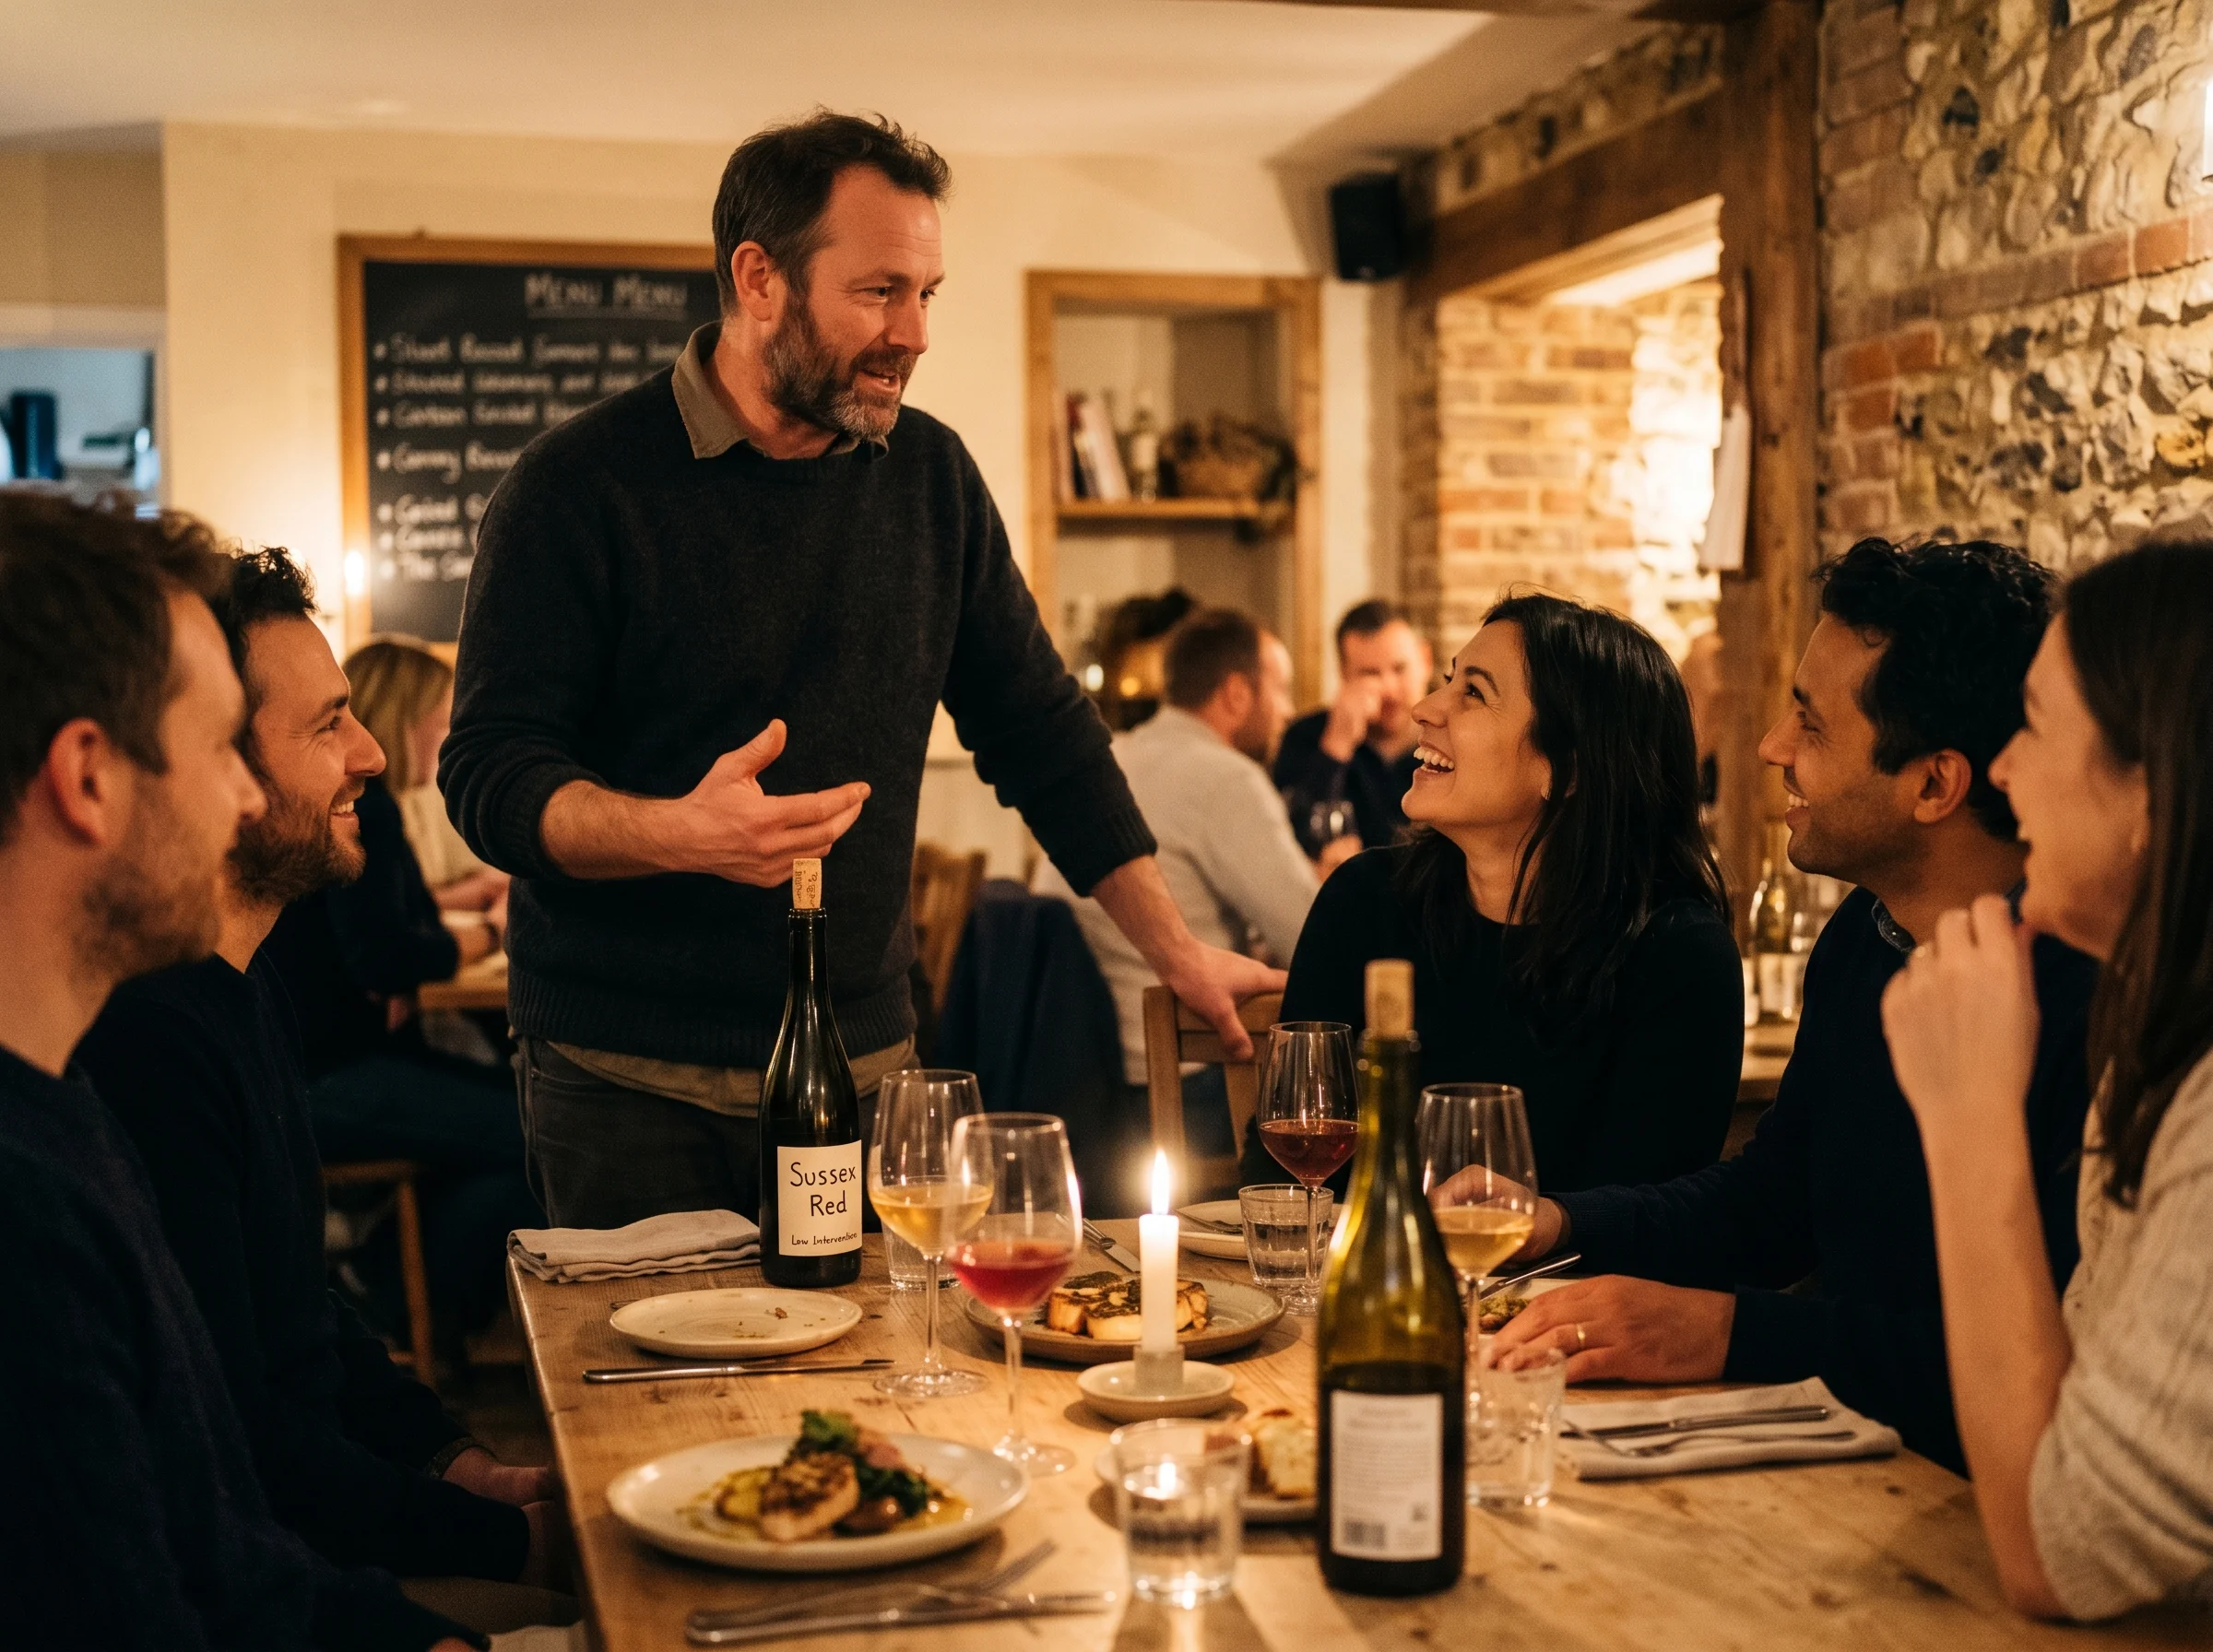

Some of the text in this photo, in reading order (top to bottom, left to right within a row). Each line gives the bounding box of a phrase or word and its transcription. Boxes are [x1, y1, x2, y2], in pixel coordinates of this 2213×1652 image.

[790, 1162, 857, 1187] Sussex
[810, 1189, 847, 1217] Red
[791, 1234, 809, 1245] Low
